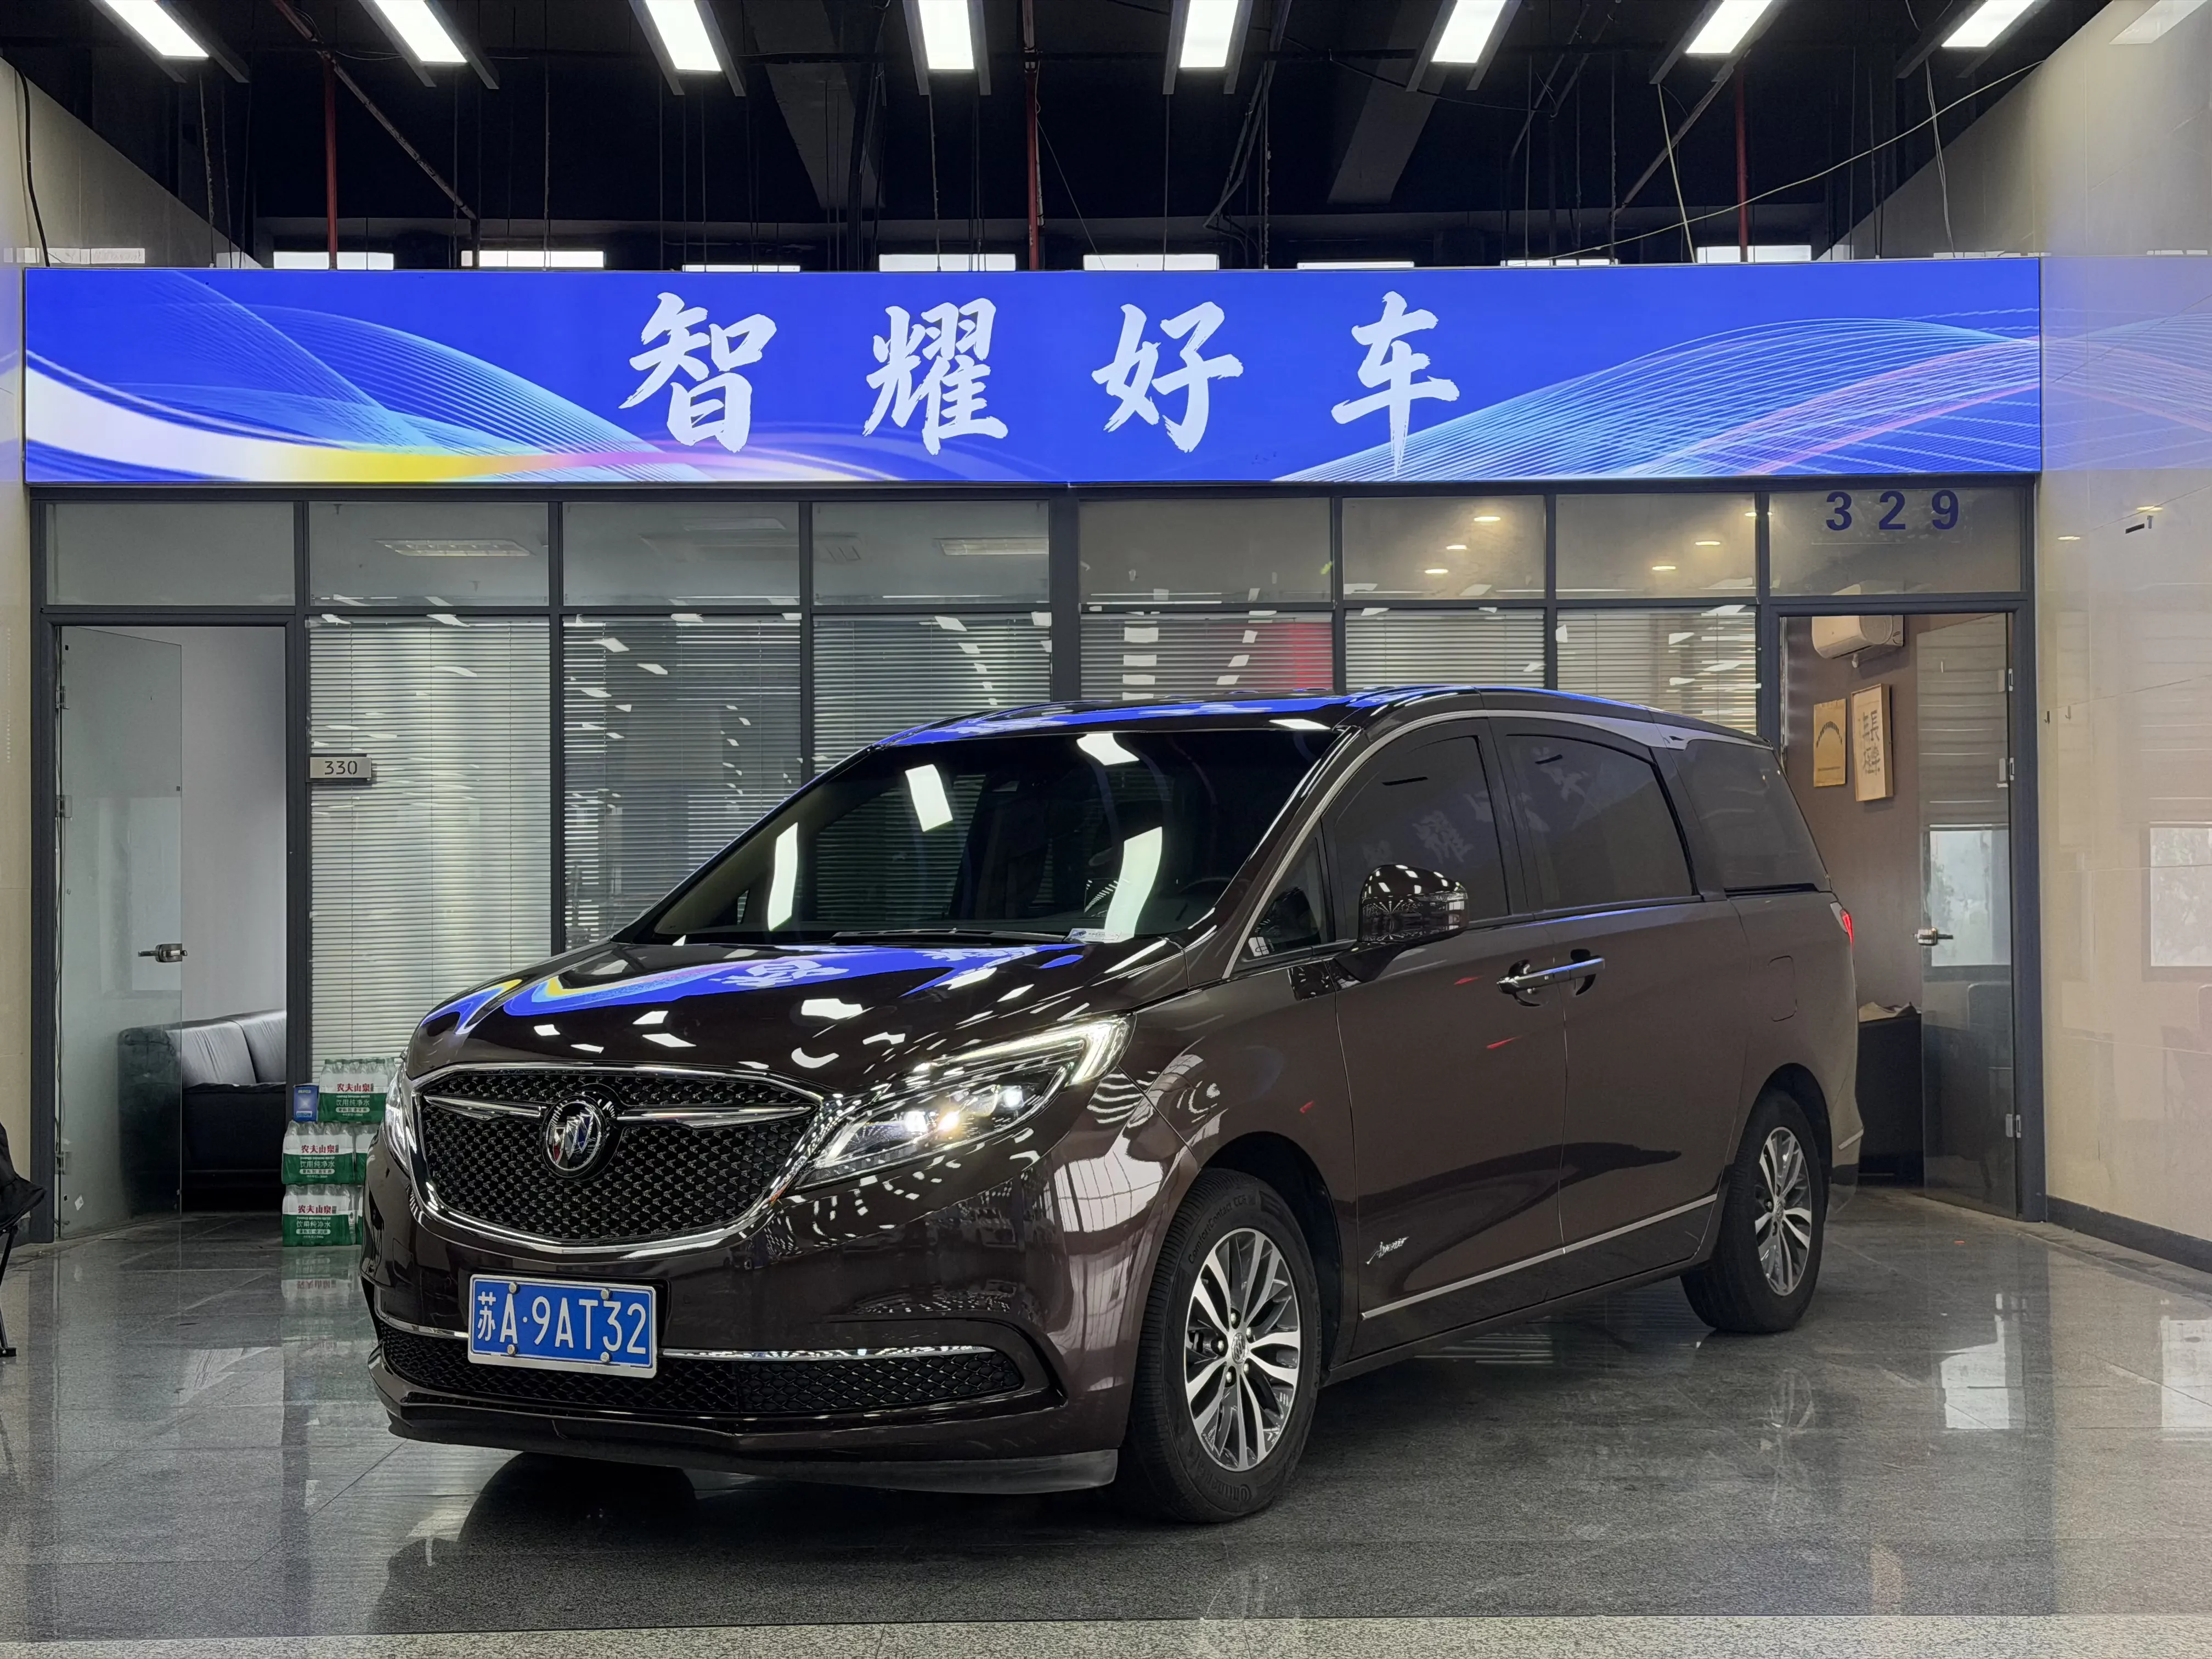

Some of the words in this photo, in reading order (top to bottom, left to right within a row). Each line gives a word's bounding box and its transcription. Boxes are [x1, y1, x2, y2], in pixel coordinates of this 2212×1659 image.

[618, 291, 1460, 476] 智耀好车
[1826, 489, 1959, 531] 329
[324, 760, 358, 775] 330
[337, 1083, 370, 1092] 农夫山泉
[301, 1144, 335, 1153] 农夫山泉
[298, 1204, 331, 1214] 农夫山泉
[477, 1291, 646, 1355] 苏A·9AT32
